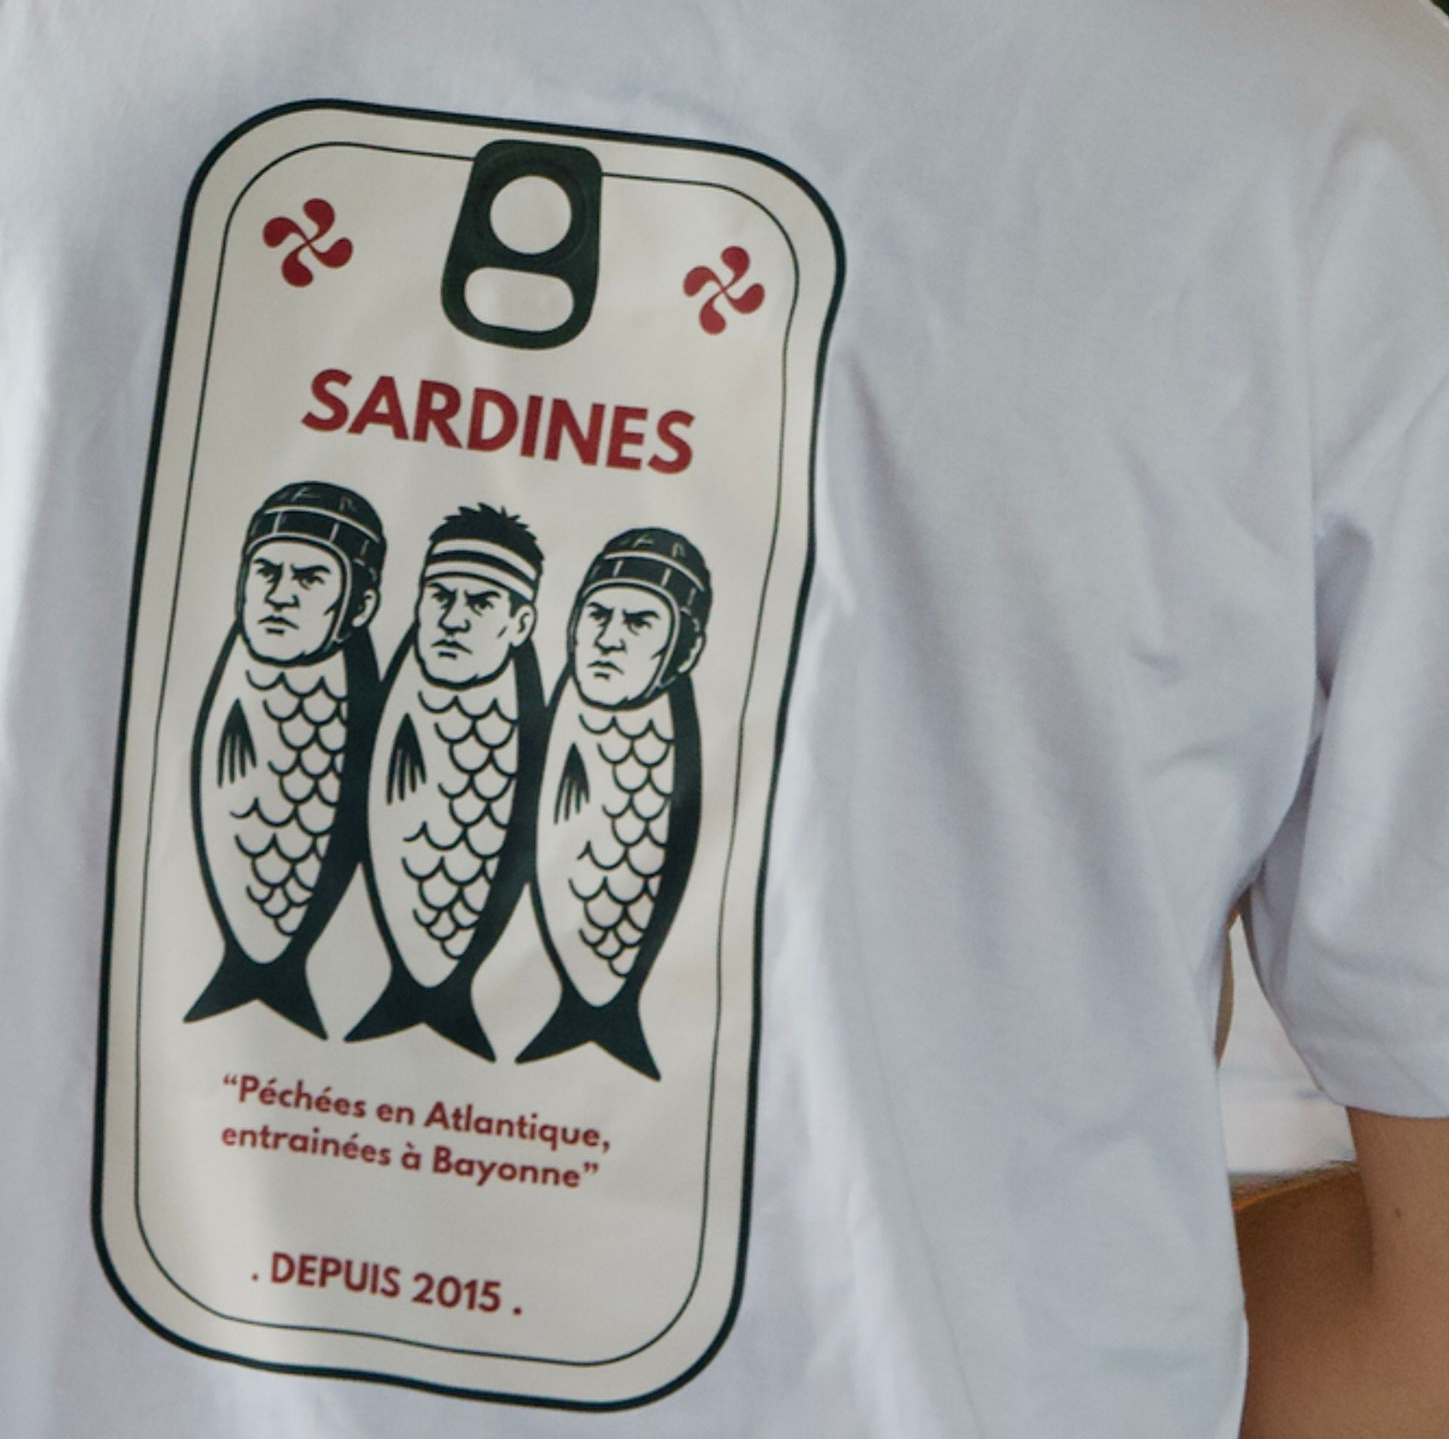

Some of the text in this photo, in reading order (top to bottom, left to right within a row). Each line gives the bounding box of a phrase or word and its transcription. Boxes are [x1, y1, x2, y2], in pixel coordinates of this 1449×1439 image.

[300, 368, 695, 476] SARDINES
[219, 1124, 392, 1167] entrainées
[399, 1142, 423, 1171] à
[375, 1103, 415, 1126] en
[423, 1100, 611, 1154] Atlantique,
[270, 1251, 401, 1299] DEPUIS
[411, 1272, 502, 1314] 2015
